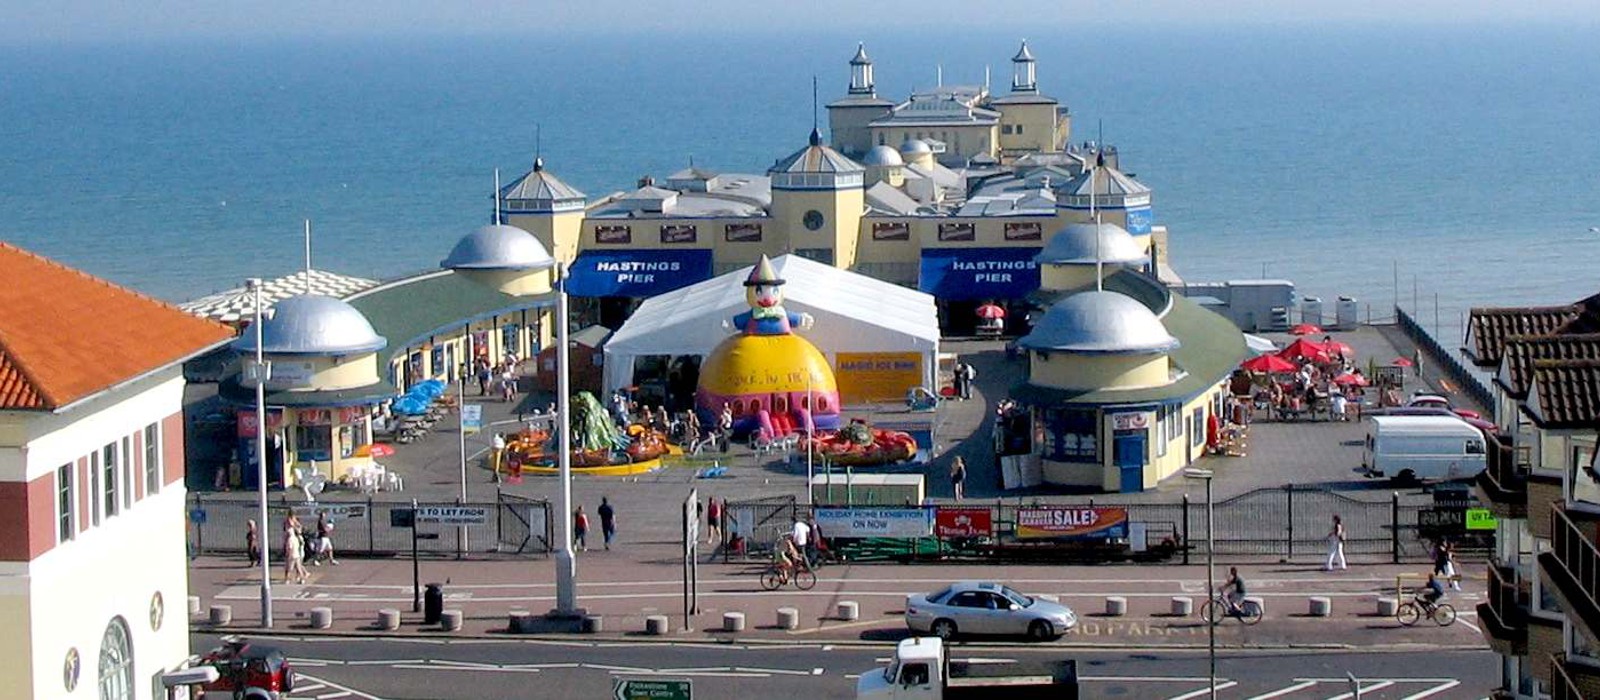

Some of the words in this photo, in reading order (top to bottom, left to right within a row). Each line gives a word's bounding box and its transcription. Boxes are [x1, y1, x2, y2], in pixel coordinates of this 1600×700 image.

[597, 262, 680, 272] HASTINGS
[953, 261, 1037, 271] HASTINGS
[617, 273, 655, 284] PIER
[975, 273, 1013, 283] PIER
[428, 508, 440, 517] TO
[441, 508, 459, 517] LET
[460, 508, 485, 517] FROM
[1053, 509, 1090, 526] SALE
[852, 520, 866, 529] ON
[867, 520, 888, 529] NOW
